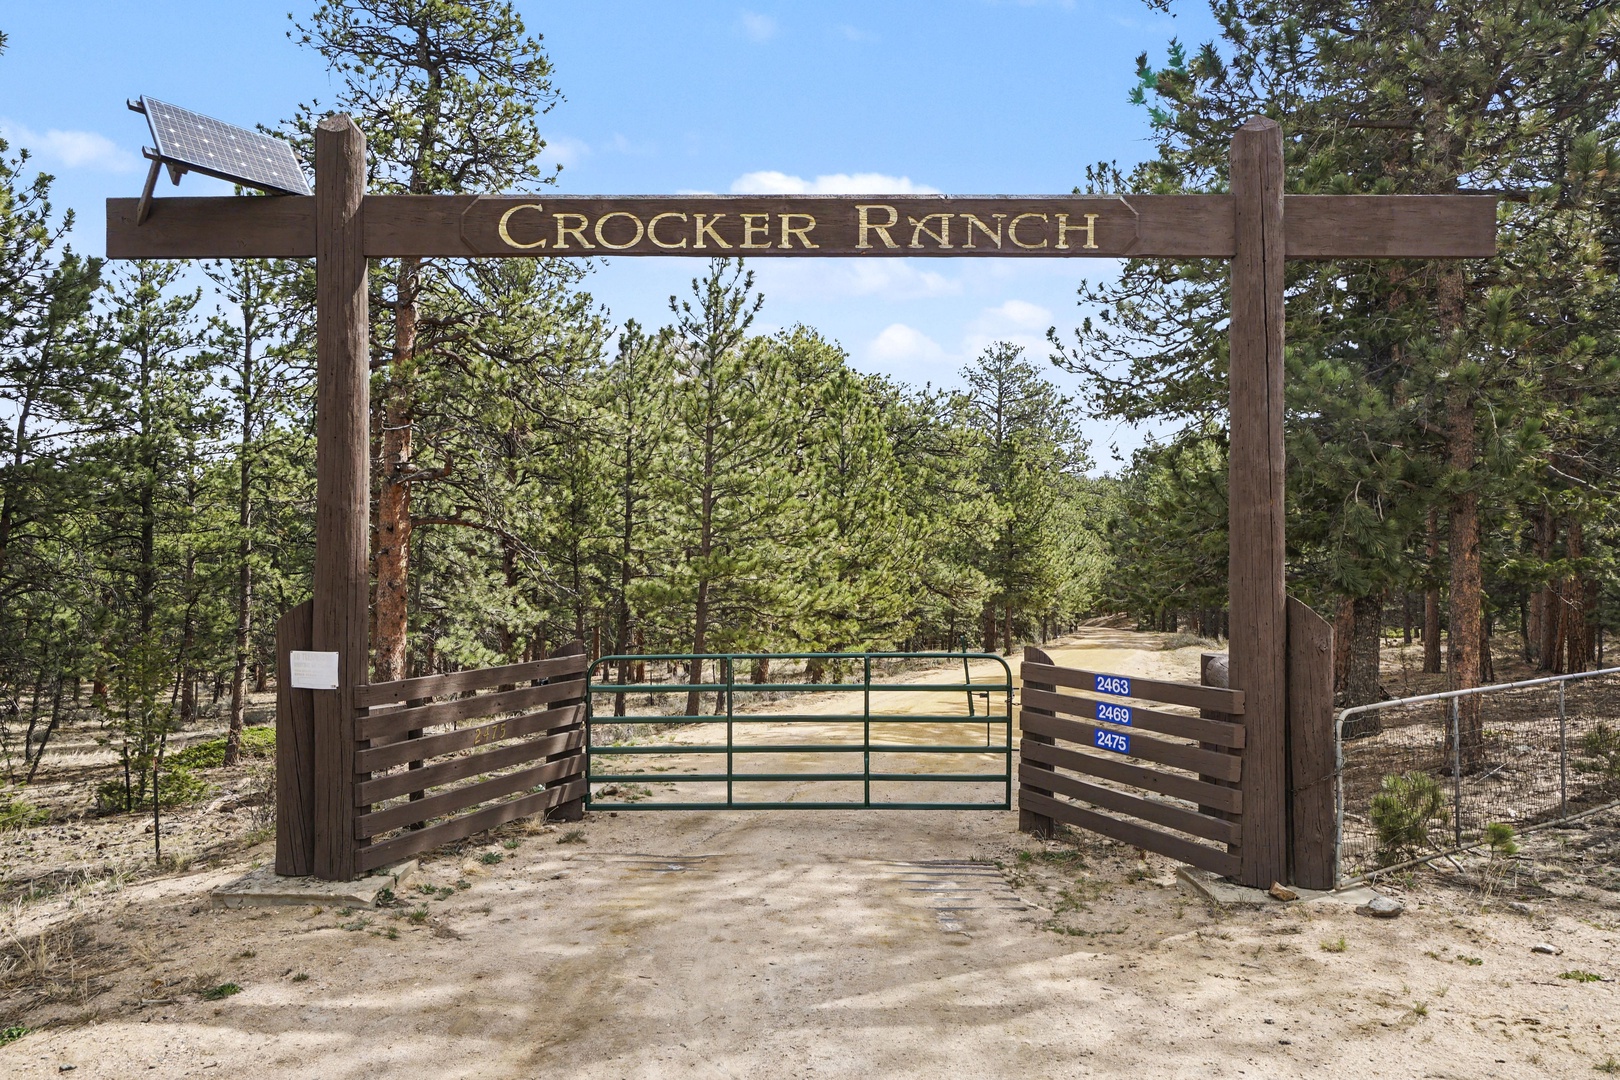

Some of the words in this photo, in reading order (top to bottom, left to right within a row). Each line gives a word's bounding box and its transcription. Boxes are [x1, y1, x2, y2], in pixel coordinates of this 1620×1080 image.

[498, 203, 820, 250] CROCKER
[854, 204, 1100, 250] RANCH
[1097, 676, 1129, 694] 2463
[1098, 704, 1129, 723] 2469
[474, 722, 507, 744] 2475
[1097, 731, 1127, 751] 2475
